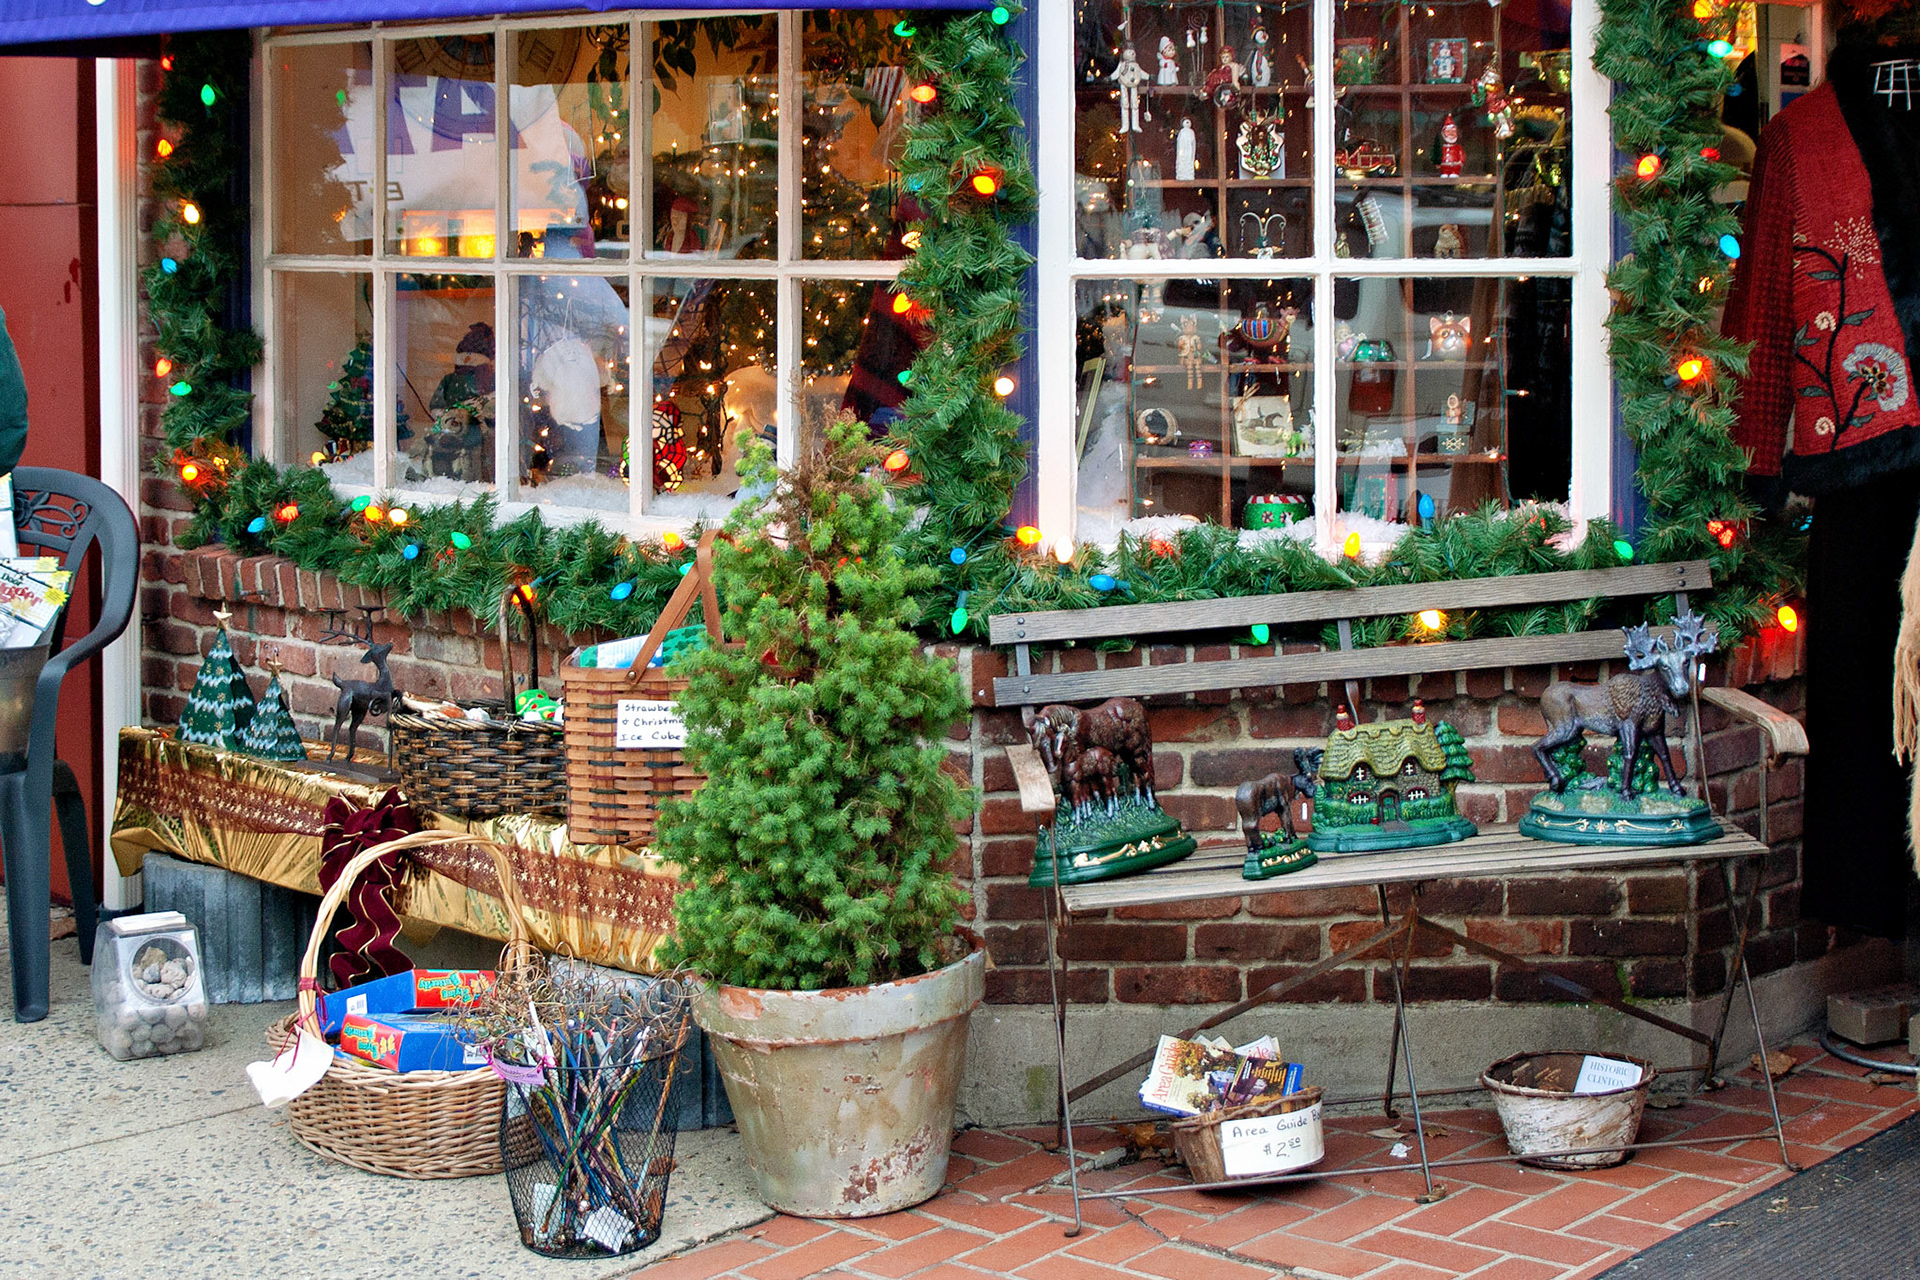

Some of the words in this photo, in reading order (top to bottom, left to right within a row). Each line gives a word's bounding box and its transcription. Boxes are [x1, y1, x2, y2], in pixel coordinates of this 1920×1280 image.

[625, 704, 669, 712] Strawbe
[633, 717, 684, 727] Christma
[619, 733, 643, 741] Ice
[1158, 1042, 1179, 1075] Guide
[1590, 1061, 1629, 1076] HISTORIC
[1587, 1073, 1626, 1088] CLINTON
[1151, 1076, 1174, 1103] Area
[1232, 1126, 1268, 1138] Area
[1276, 1115, 1308, 1131] Guide
